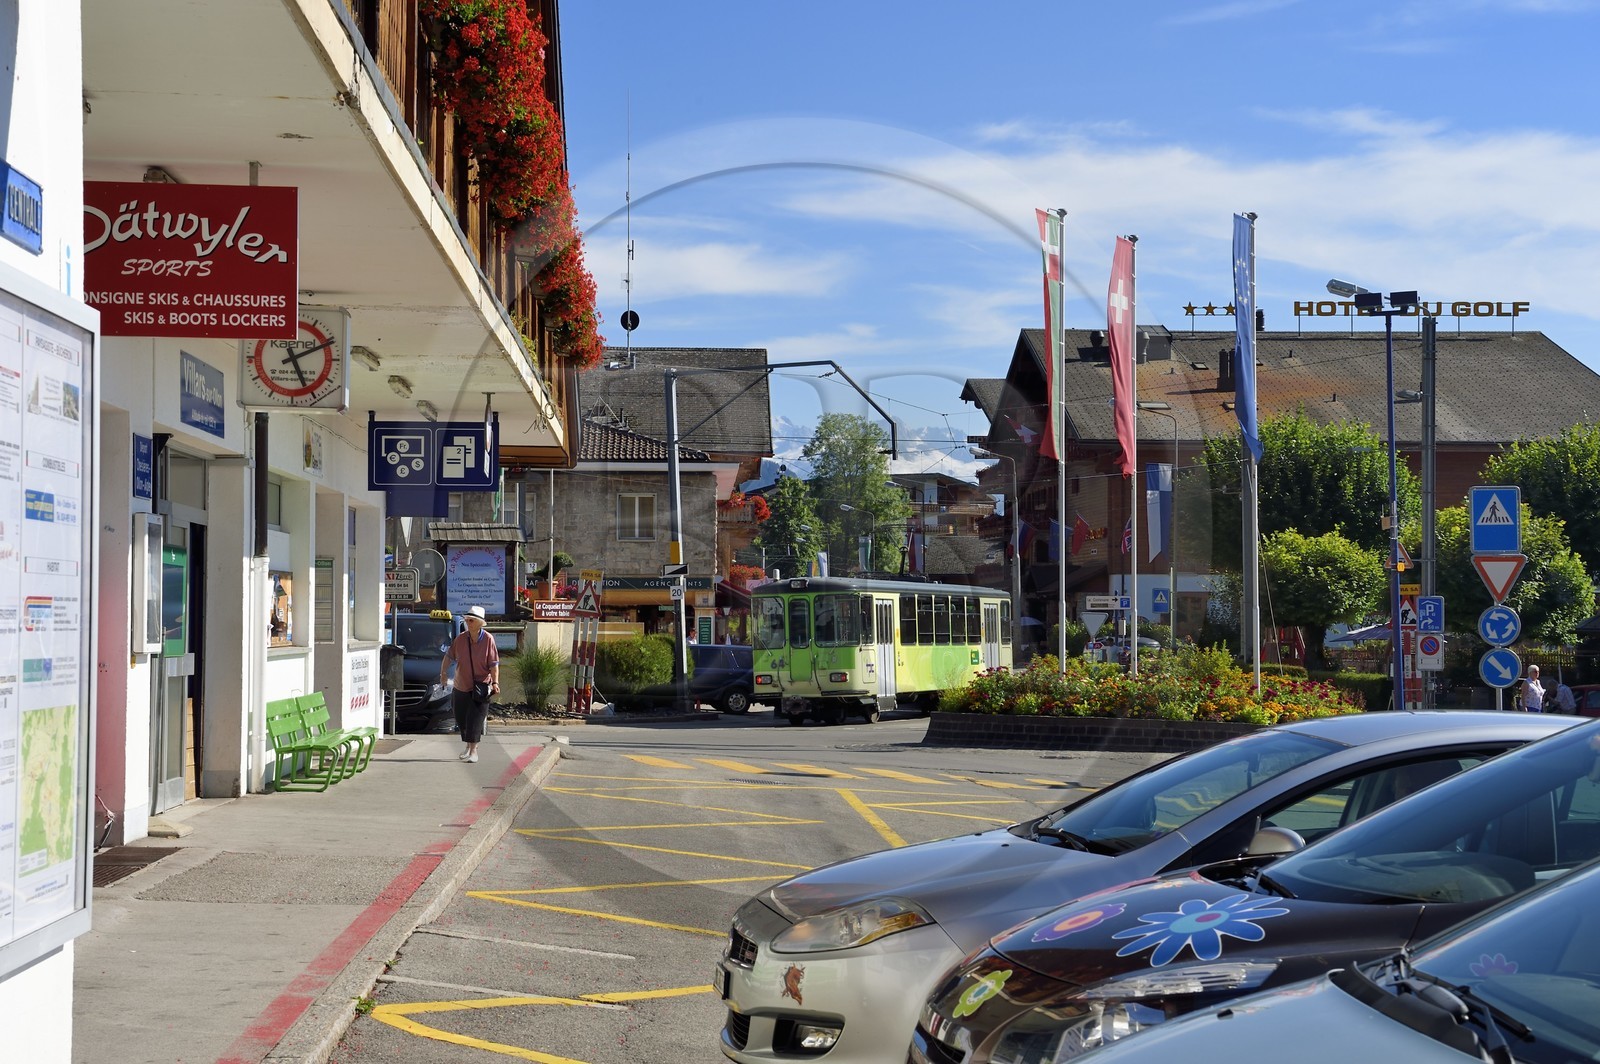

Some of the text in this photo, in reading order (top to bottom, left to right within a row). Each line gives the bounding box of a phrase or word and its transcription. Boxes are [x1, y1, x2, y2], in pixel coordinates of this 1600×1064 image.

[121, 258, 214, 277] SPORTS
[148, 294, 178, 306] SKIS
[182, 295, 190, 306] &
[193, 294, 286, 308] CHAUSSURES
[1452, 301, 1530, 317] GOLF
[124, 312, 286, 327] SKIS & BOOTS LOCKERS
[271, 339, 316, 349] Kaenel
[1426, 604, 1434, 616] P
